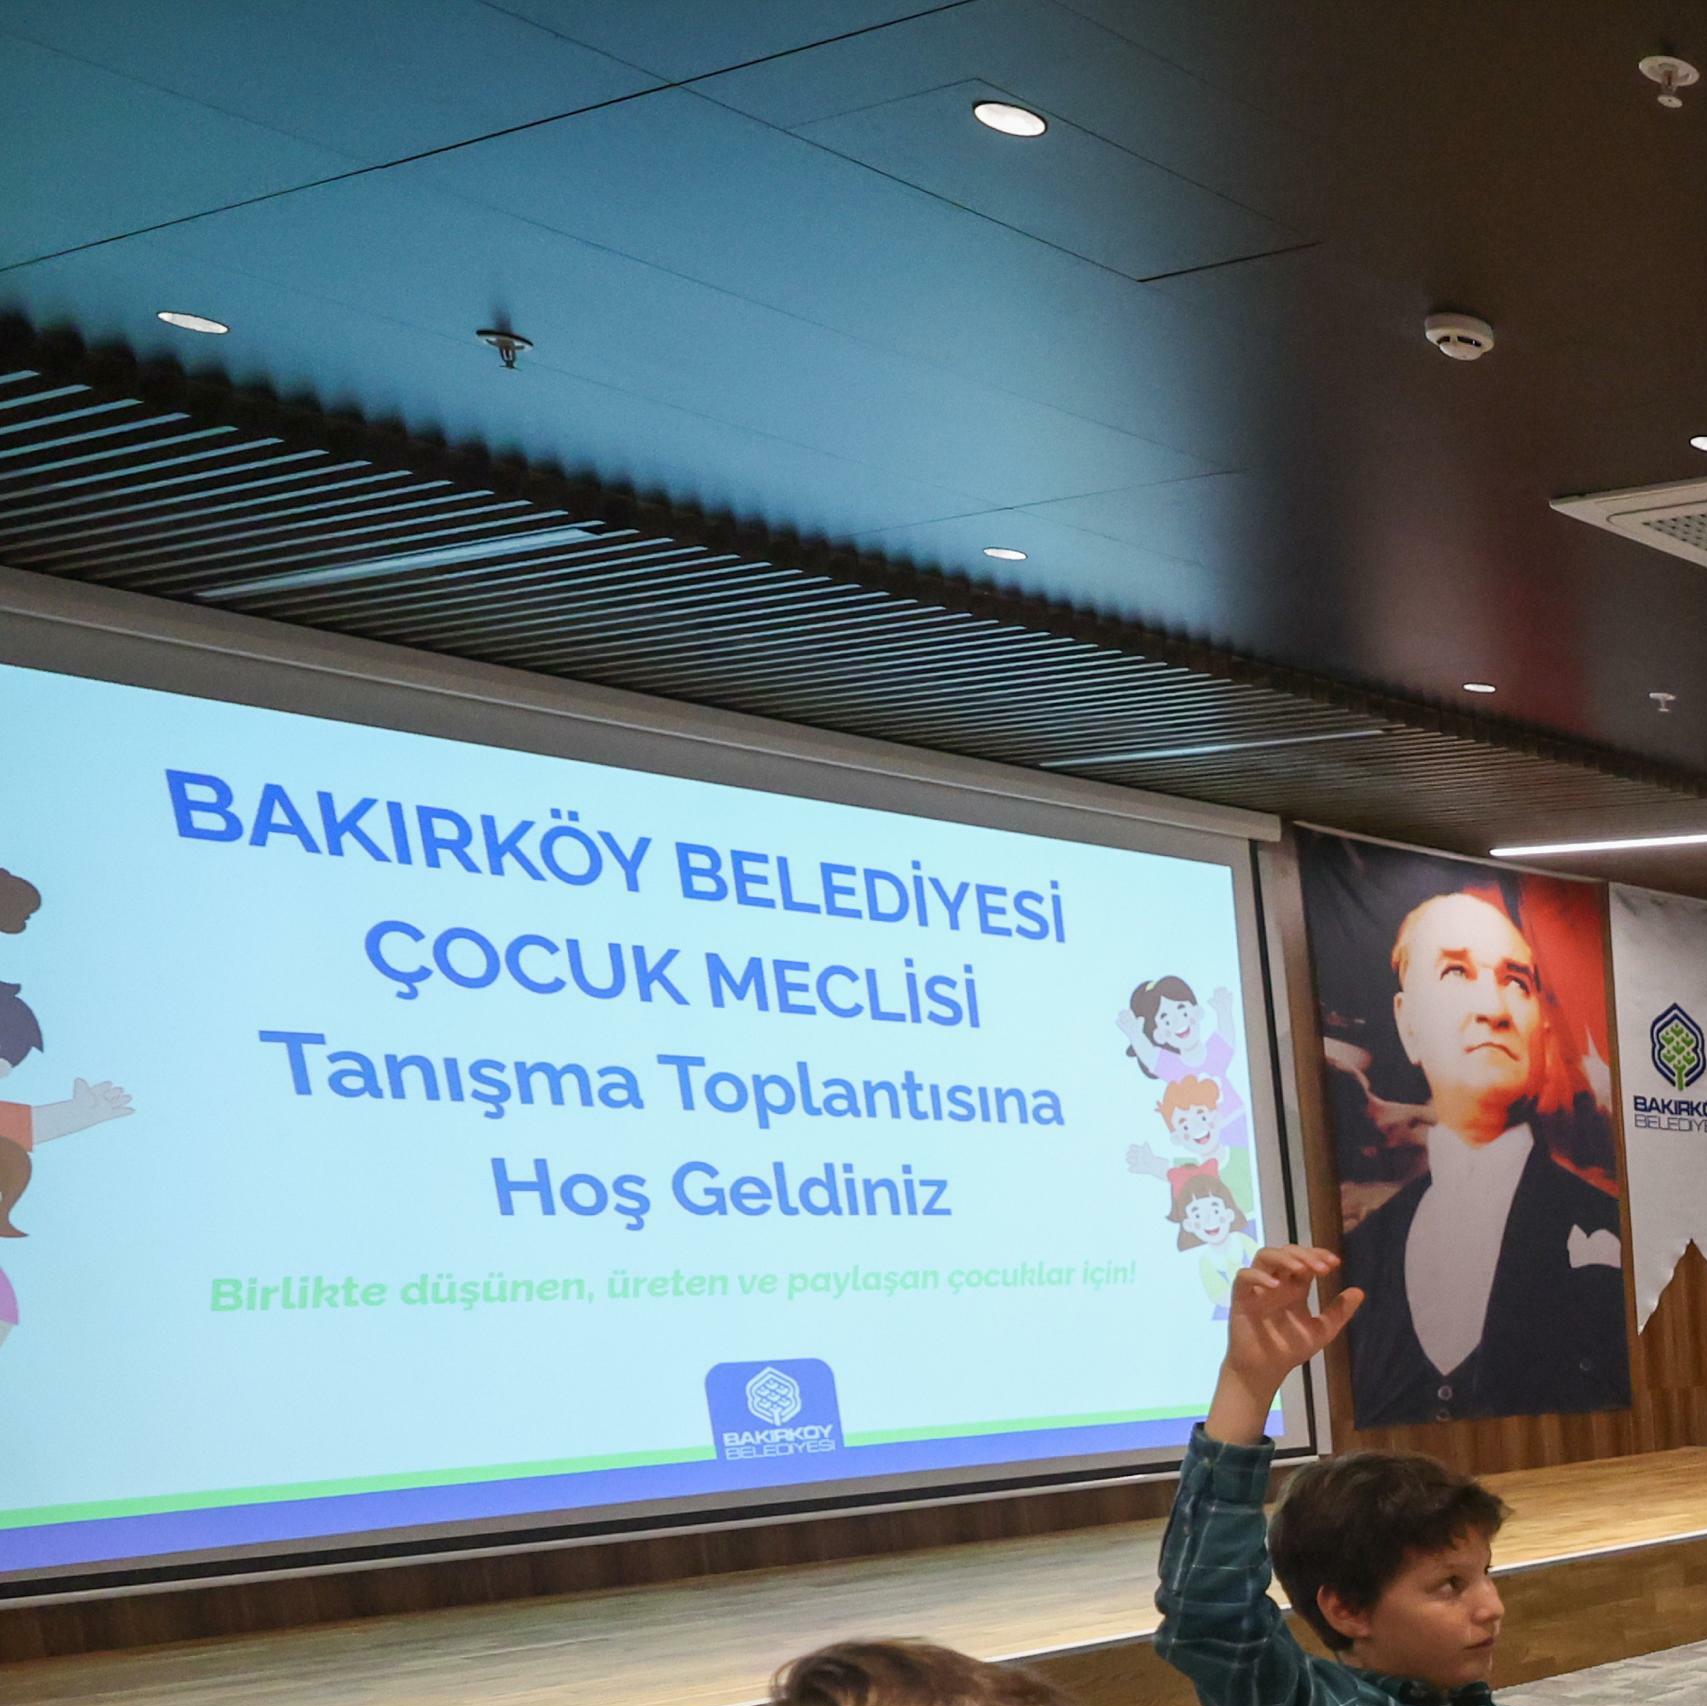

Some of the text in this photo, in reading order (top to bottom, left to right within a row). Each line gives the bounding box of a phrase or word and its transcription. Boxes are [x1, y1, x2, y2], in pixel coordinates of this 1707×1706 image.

[165, 766, 1066, 944] BAKIRKÖY BELEDİYESİ
[364, 918, 981, 1028] ÇOCUK MECLİSİ
[258, 1030, 1065, 1129] Tanışma Toplantısına
[492, 1157, 951, 1231] Hoş Geldiniz
[210, 1260, 1136, 1312] Birlikte düşünen, üreten ve paylaşan çocuklar için!
